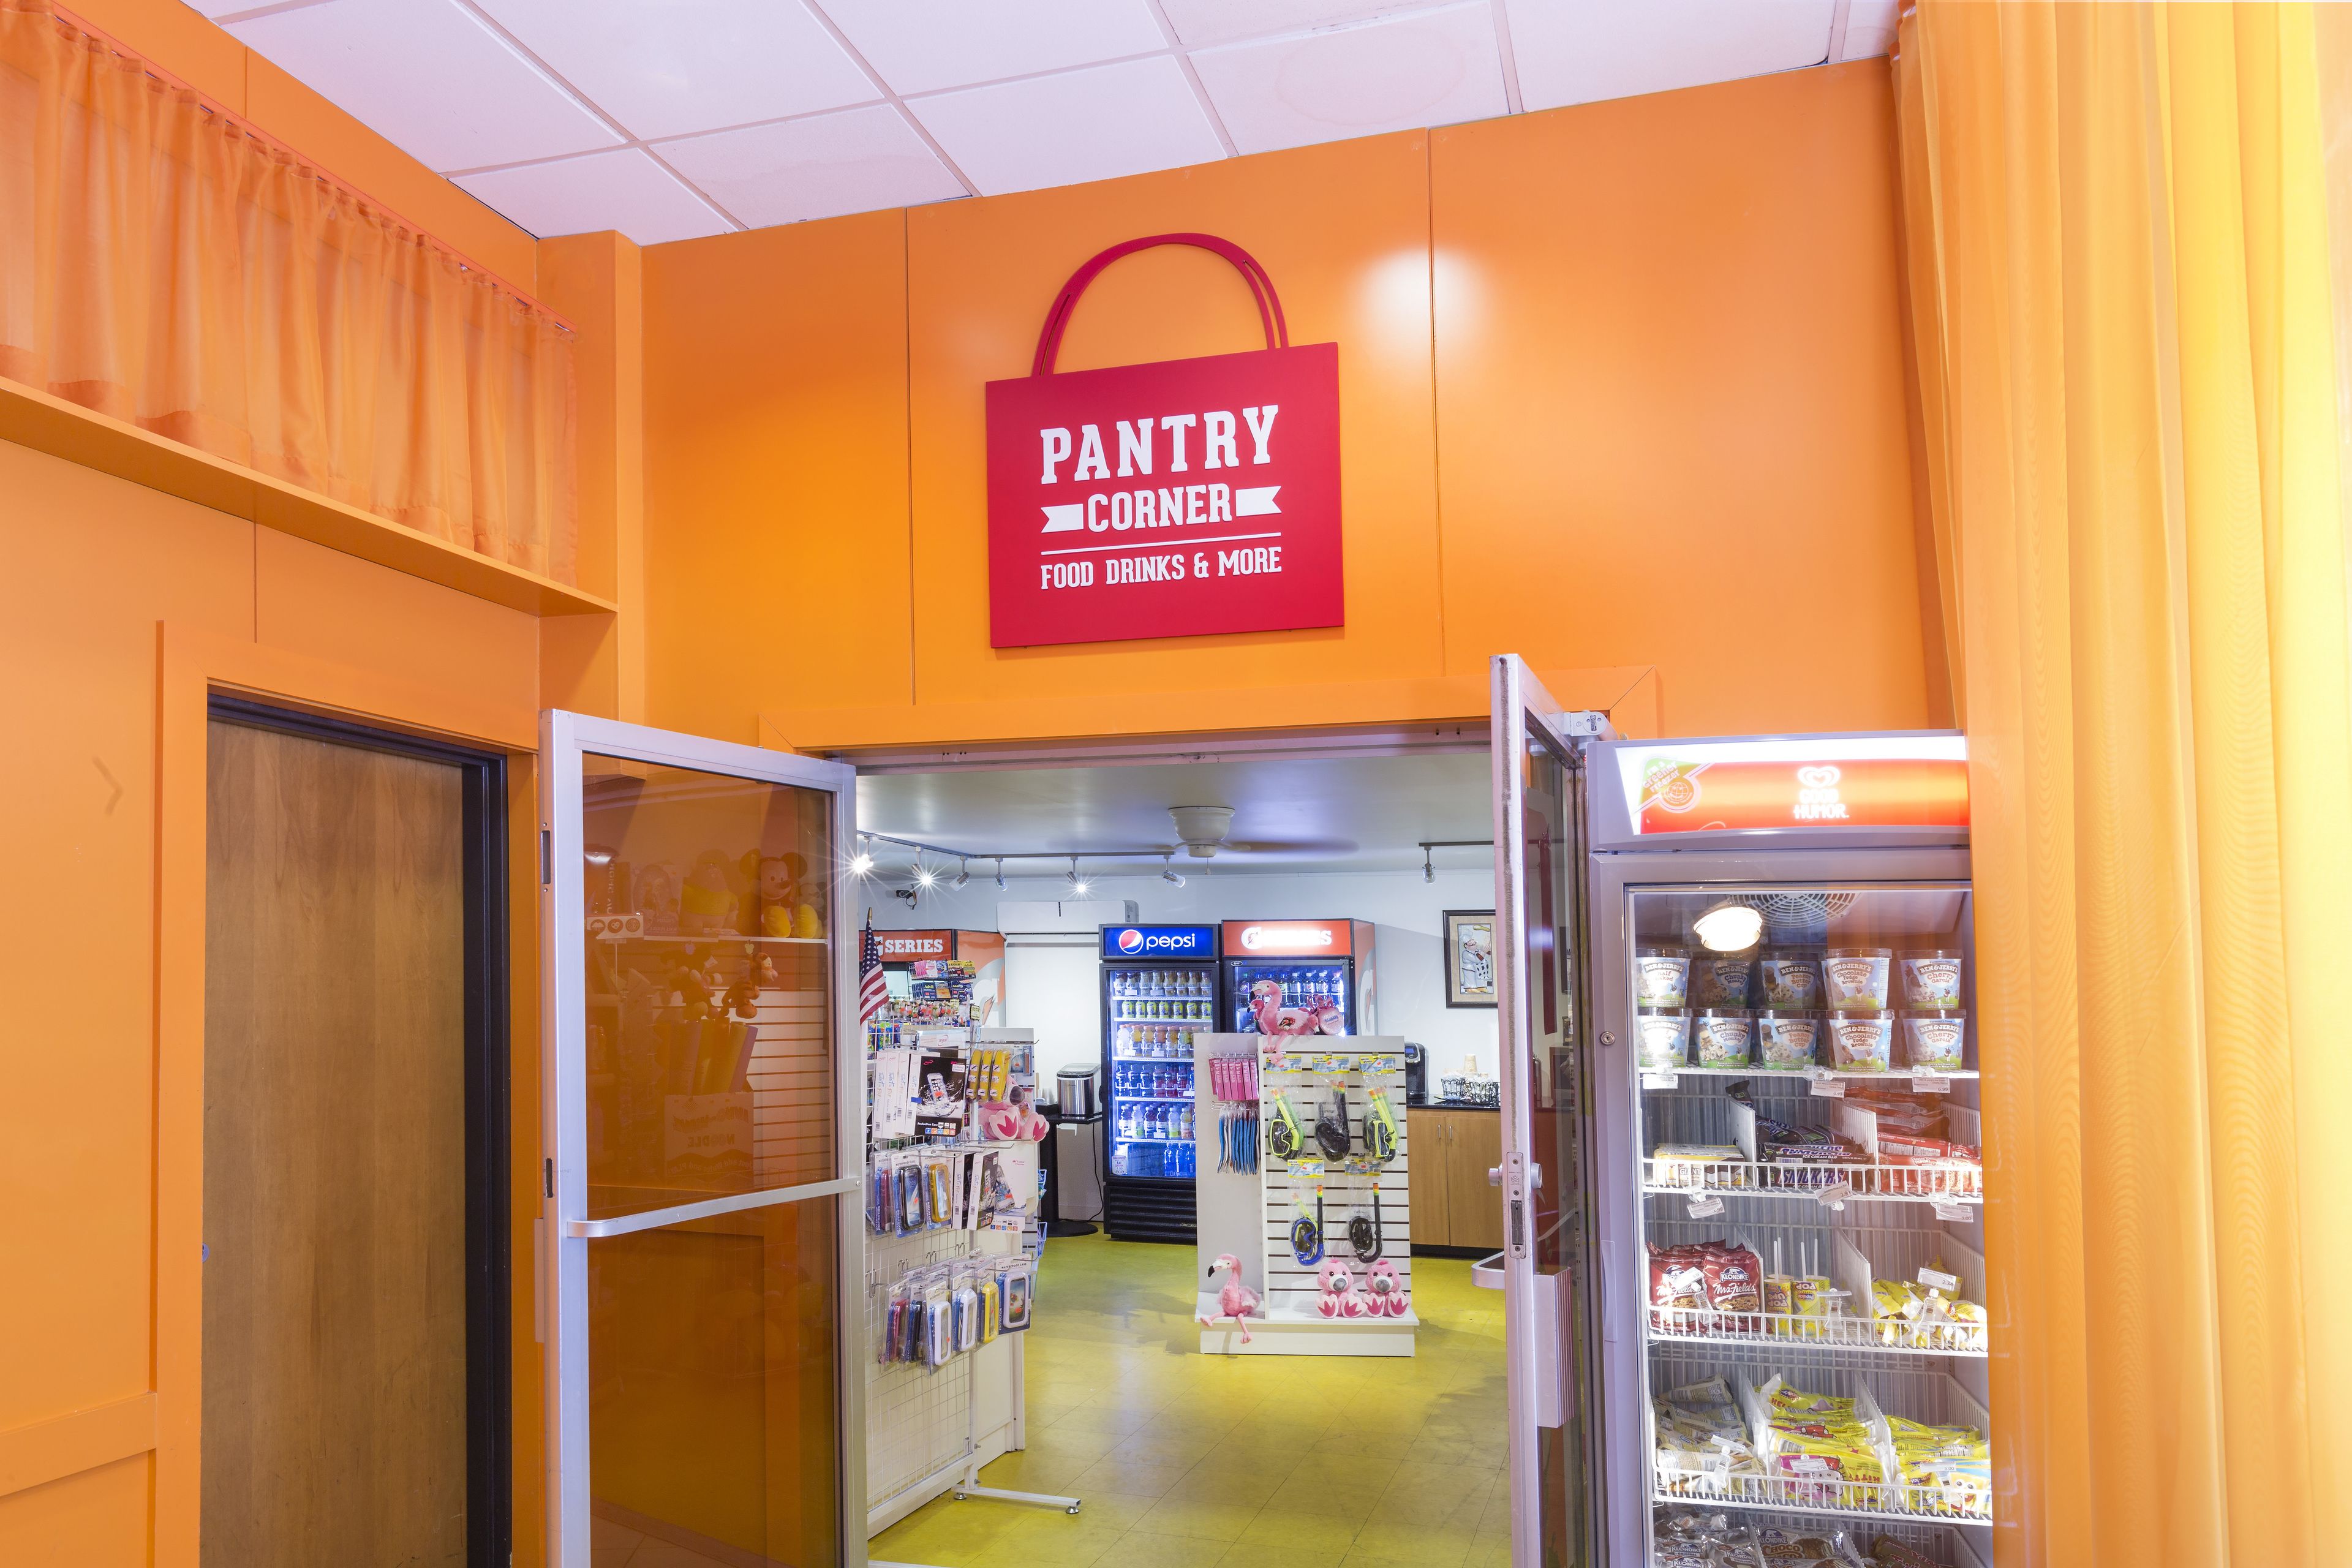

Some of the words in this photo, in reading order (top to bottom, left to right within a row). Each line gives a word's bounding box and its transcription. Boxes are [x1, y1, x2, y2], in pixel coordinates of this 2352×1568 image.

[1041, 404, 1279, 484] PANTRY
[1087, 483, 1232, 532] CORNER
[1041, 560, 1094, 590] FOOD
[1106, 553, 1185, 584] DRINKS
[1194, 552, 1210, 578] &
[1218, 546, 1283, 577] MORE
[884, 938, 944, 954] SERIES
[1146, 933, 1196, 951] pepsi
[1927, 1031, 1954, 1039] Cherry
[1795, 1282, 1817, 1291] POP
[1762, 1544, 1801, 1555] CHOCO
